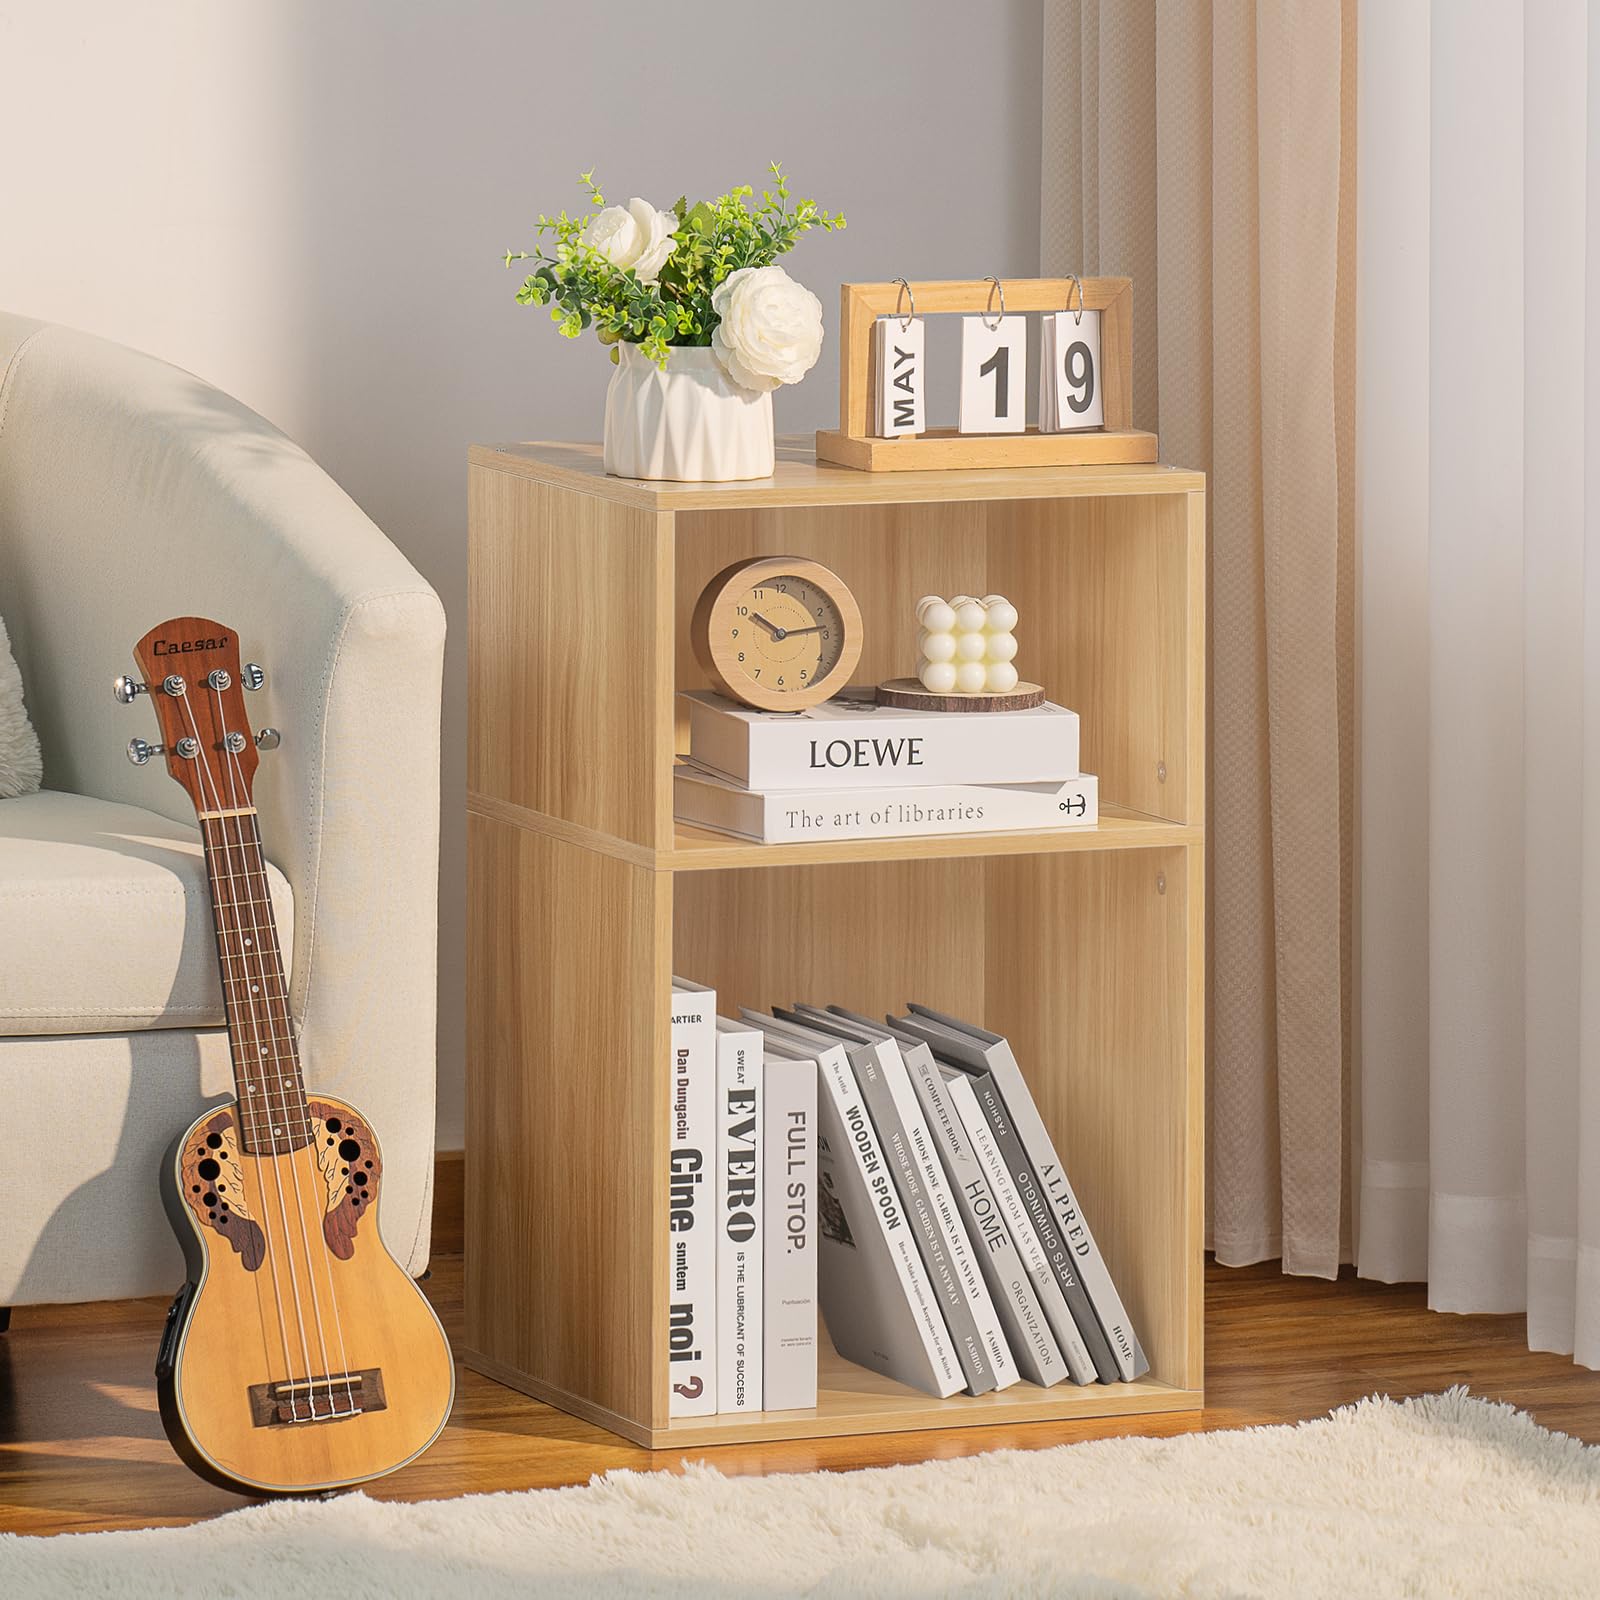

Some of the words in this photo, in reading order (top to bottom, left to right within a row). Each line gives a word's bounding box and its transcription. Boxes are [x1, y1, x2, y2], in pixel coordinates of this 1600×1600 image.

[894, 345, 915, 427] MAY
[980, 346, 1009, 418] 1
[1064, 341, 1094, 413] 9
[753, 590, 763, 599] 11
[776, 584, 786, 593] 12
[802, 591, 806, 600] 1
[736, 606, 748, 616] 10
[817, 608, 824, 616] 2
[154, 637, 227, 656] Caesar
[732, 629, 739, 639] 9
[823, 631, 829, 640] 3
[738, 652, 745, 662] 8
[755, 670, 761, 679] 7
[800, 670, 807, 679] 5
[816, 652, 823, 662] 4
[777, 676, 784, 685] 6
[809, 738, 924, 768] LOEWE
[786, 810, 824, 828] The
[833, 807, 860, 827] art
[870, 805, 892, 825] of
[899, 802, 985, 823] libraries
[677, 1049, 689, 1074] Dan
[736, 1050, 745, 1084] SWEAT
[865, 1062, 877, 1081] THE
[674, 1078, 689, 1140] Dungaciu
[924, 1077, 950, 1126] COMPLETE
[946, 1127, 962, 1154] BOOK
[983, 1091, 1007, 1136] FASHION
[788, 1112, 806, 1175] FULL
[891, 1133, 910, 1169] WHOSE
[911, 1128, 930, 1163] WHOSE
[727, 1087, 756, 1243] EVERO
[845, 1106, 880, 1174] WOODEN
[871, 1176, 901, 1230] SPOON
[904, 1169, 920, 1196] ROSE
[925, 1164, 940, 1190] ROSE
[670, 1148, 703, 1232] Cine
[976, 1128, 1006, 1186] LEARNING
[1002, 1189, 1021, 1220] FROM
[1018, 1223, 1032, 1245] LAS
[1028, 1248, 1050, 1285] VEGAS
[788, 1183, 806, 1254] STOP.
[914, 1199, 935, 1239] GARDEN
[935, 1193, 957, 1233] GARDEN
[964, 1180, 1008, 1253] HOME
[1018, 1172, 1058, 1250] CHIWINGLO
[1040, 1161, 1092, 1258] ALPRED
[736, 1252, 745, 1261] IS
[930, 1240, 939, 1251] IS
[934, 1251, 944, 1263] IT
[951, 1235, 960, 1245] IS
[955, 1246, 964, 1256] IT
[736, 1263, 745, 1282] THE
[938, 1264, 960, 1306] ANYWAY
[959, 1259, 980, 1299] ANYWAY
[1053, 1252, 1075, 1289] ARTS
[736, 1286, 745, 1340] LUBRICANT
[1011, 1281, 1054, 1366] ORGANIZATION
[669, 1303, 701, 1362] noi
[736, 1340, 745, 1357] OF
[986, 1331, 1005, 1368] FASHION
[1113, 1326, 1133, 1361] HOME
[964, 1336, 985, 1375] FASHION
[673, 1376, 703, 1399] ?
[736, 1360, 745, 1406] SUCCESS
